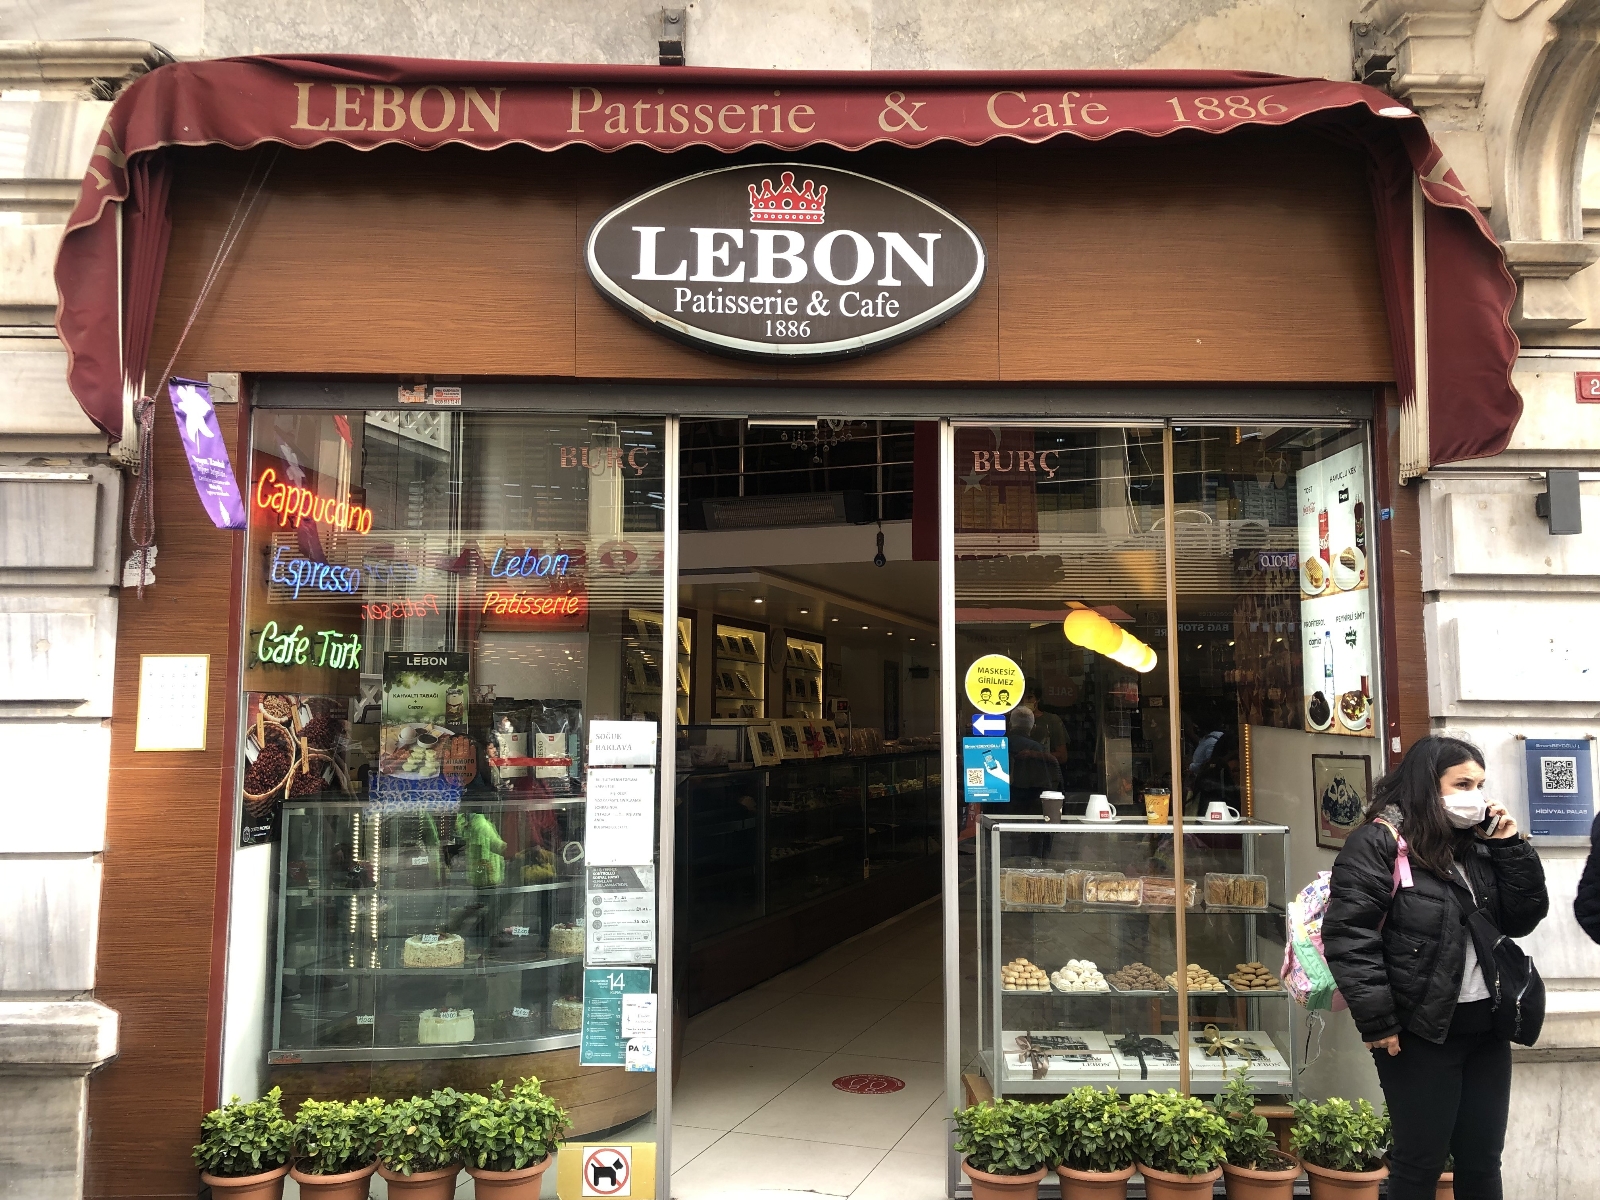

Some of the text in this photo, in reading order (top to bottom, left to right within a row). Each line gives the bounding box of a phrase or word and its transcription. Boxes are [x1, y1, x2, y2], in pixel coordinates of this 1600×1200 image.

[291, 82, 1290, 135] LEBON Patisserie & Cafe 1886
[631, 225, 942, 288] LEBON
[674, 287, 900, 319] Patisserie & Cafe
[764, 320, 811, 339] 1886
[971, 450, 1060, 479] BURÇ
[256, 467, 373, 535] Cappuccino
[271, 546, 361, 600] Espresso
[491, 547, 570, 578] Lebon
[482, 590, 580, 615] Patisserie
[258, 620, 310, 665] Cafe
[406, 656, 448, 666] LEBON
[977, 666, 1016, 676] MASKESİZ
[977, 676, 1014, 686] GİRİLMEZ
[595, 731, 622, 740] SOĞUK
[607, 972, 625, 991] 14
